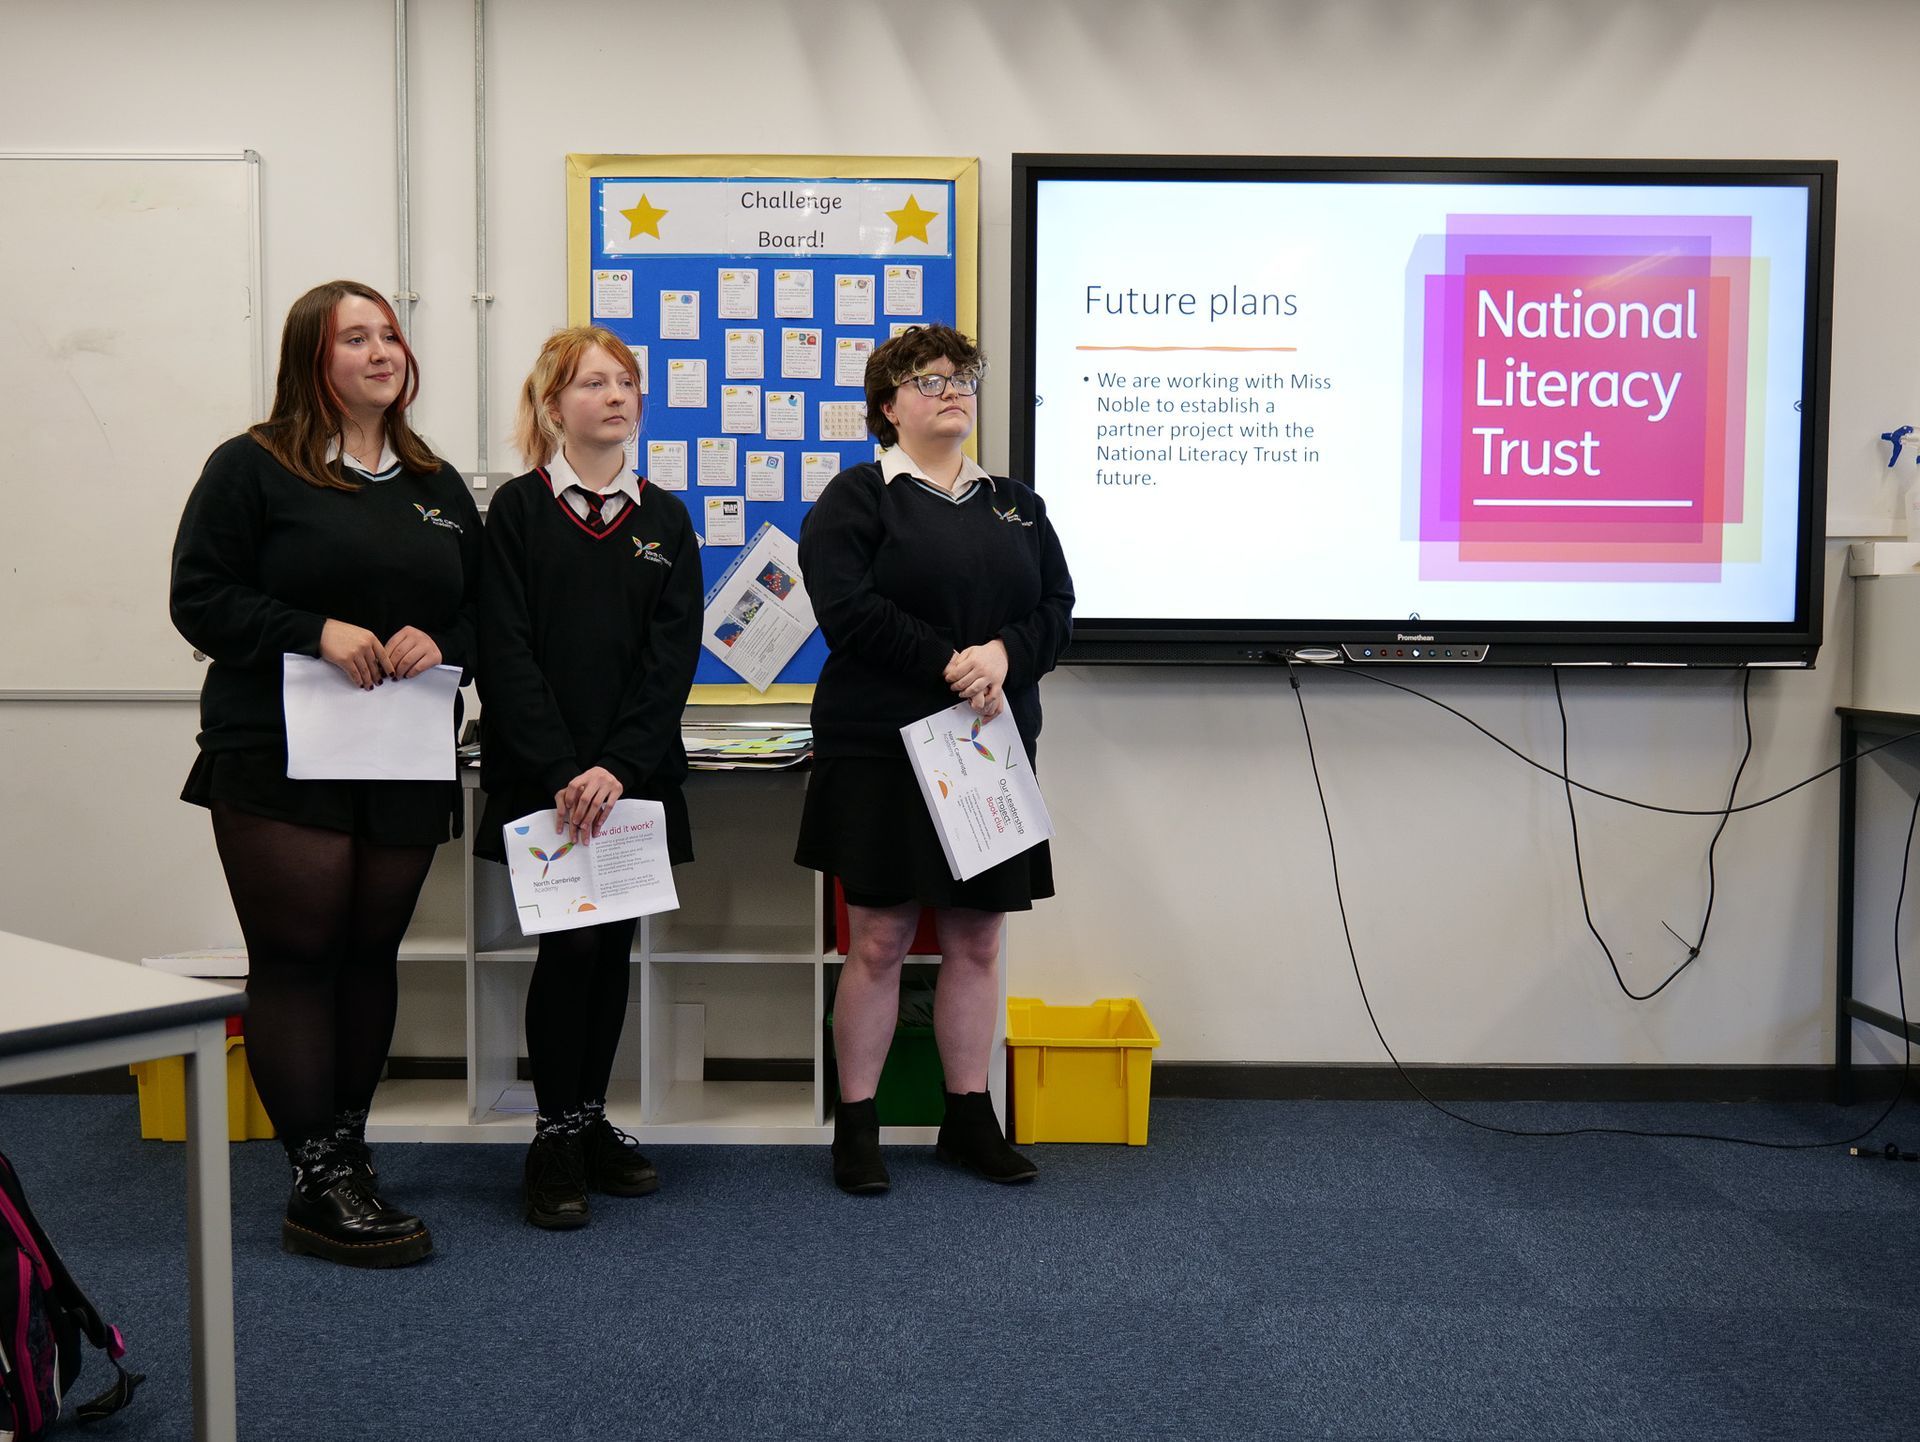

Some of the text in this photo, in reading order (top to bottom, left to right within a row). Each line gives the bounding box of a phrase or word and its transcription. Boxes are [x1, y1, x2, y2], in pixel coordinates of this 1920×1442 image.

[741, 190, 842, 215] Challenge
[758, 229, 826, 248] Board!
[1086, 284, 1298, 323] Future plans
[1478, 288, 1697, 339] National
[1097, 372, 1331, 393] We are working with Miss
[1477, 357, 1682, 422] Literacy
[1097, 396, 1275, 413] Noble to establish a
[1097, 422, 1314, 441] partner project with the
[1096, 445, 1319, 465] National Literacy Trust in
[1472, 427, 1601, 476] Trust
[1096, 469, 1156, 486] future.
[1397, 633, 1435, 641] Promethean
[948, 730, 967, 776] North Cambridge
[986, 796, 1005, 834] Book club
[997, 796, 1012, 826] Project:
[999, 778, 1025, 835] Our Leadership
[609, 825, 621, 835] did
[630, 820, 654, 832] work?
[533, 876, 581, 888] North Cambridge
